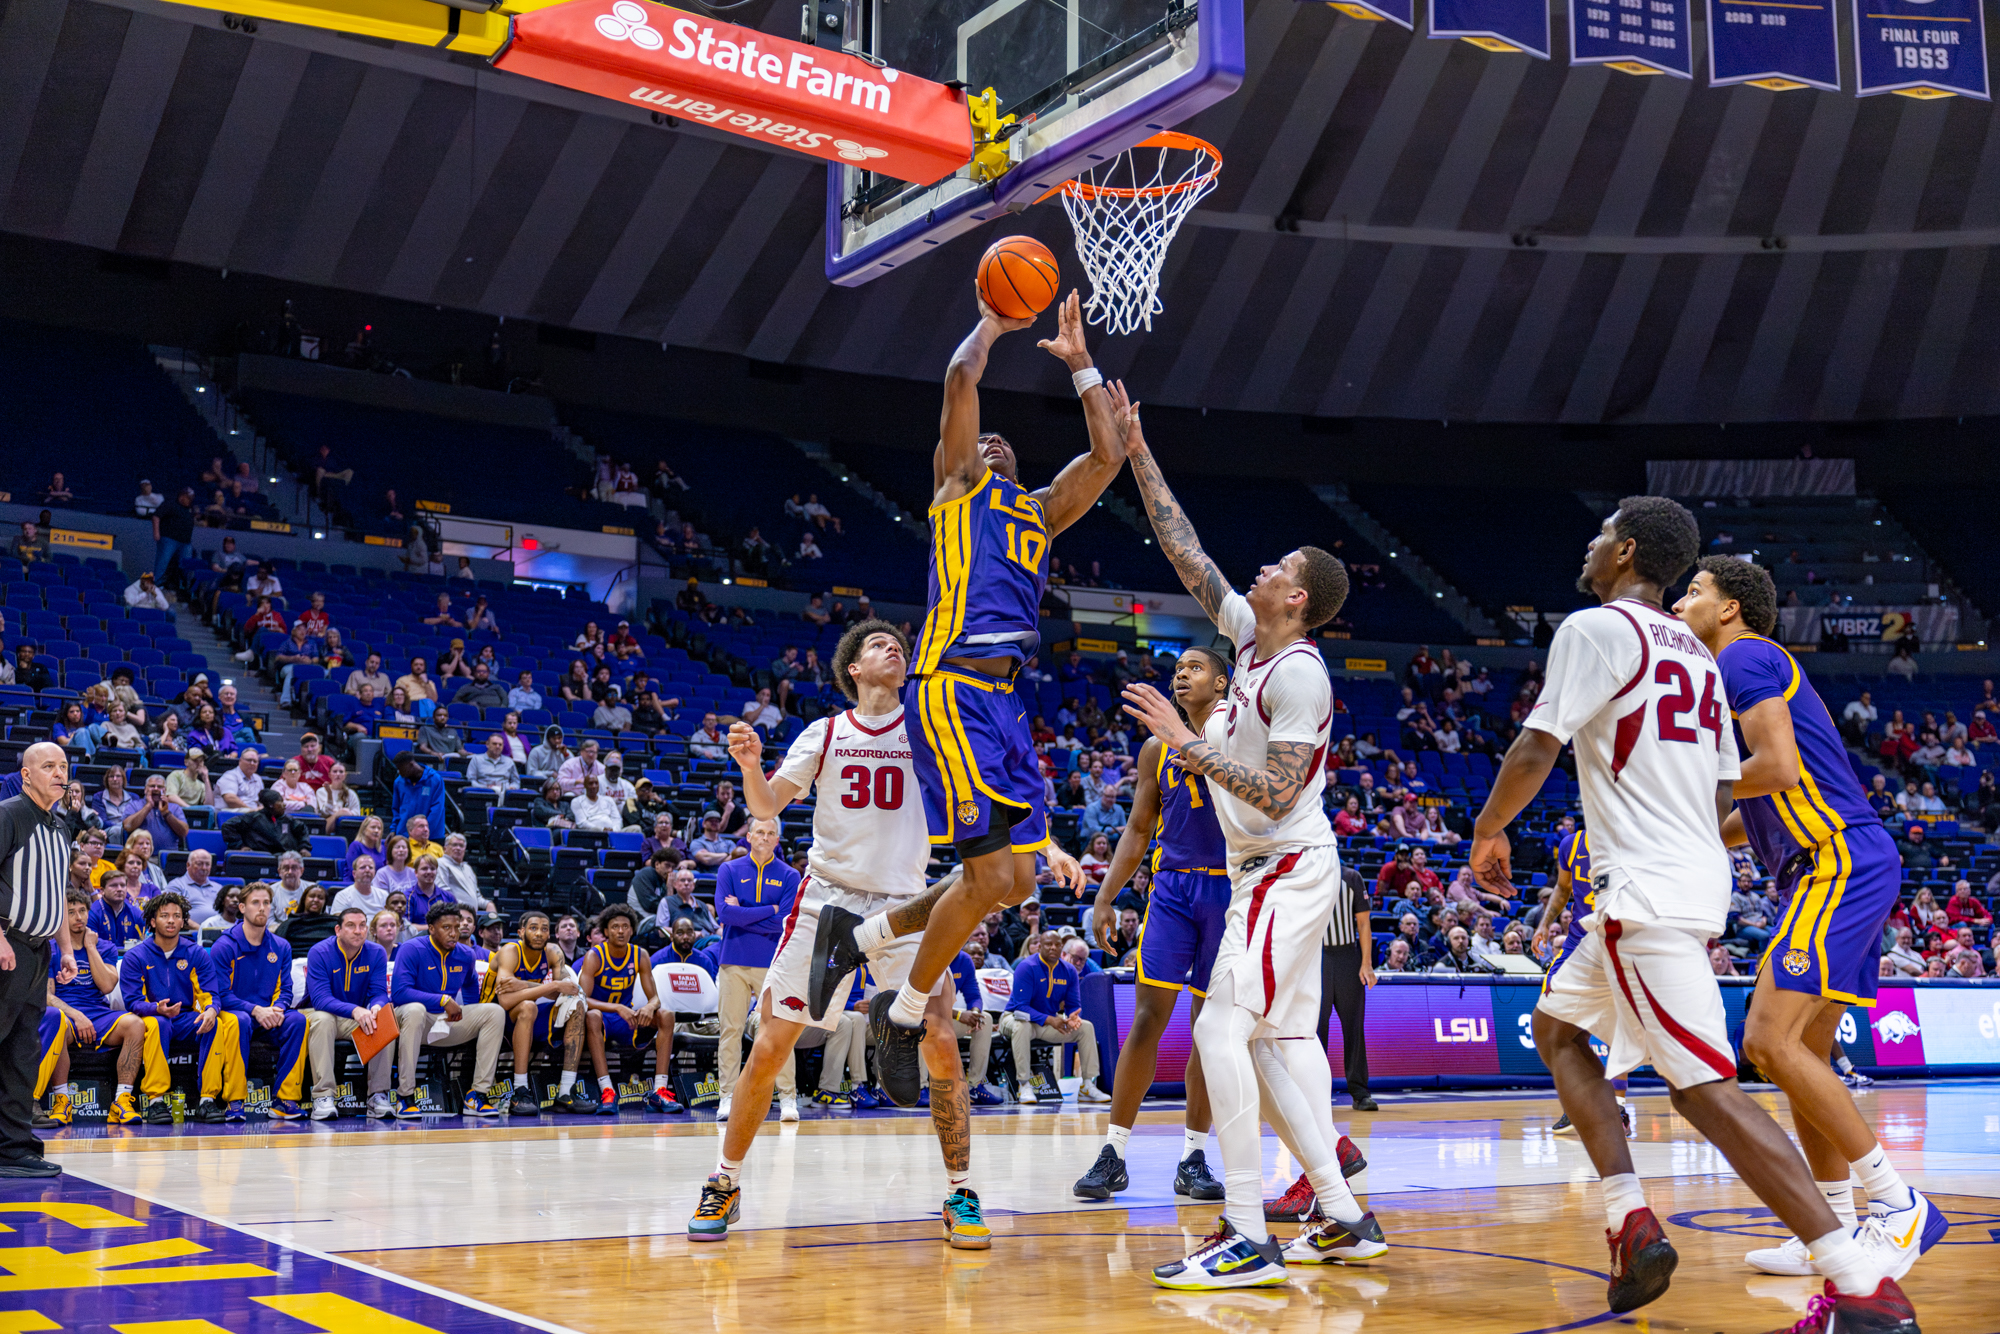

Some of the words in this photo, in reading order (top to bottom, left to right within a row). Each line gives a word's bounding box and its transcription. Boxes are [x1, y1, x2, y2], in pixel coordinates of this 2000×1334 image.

[1881, 27, 1920, 44] FINAL
[1923, 30, 1960, 45] FOUR
[1894, 46, 1949, 69] 1953
[1005, 522, 1047, 575] 10
[1822, 618, 1880, 636] WBRZ
[1655, 659, 1724, 754] 24
[834, 748, 913, 760] RAZORBACKS
[841, 765, 904, 810] 30
[1185, 773, 1204, 809] 1
[765, 878, 783, 887] LSU
[354, 965, 370, 974] LSU
[449, 965, 463, 973] LSU
[600, 976, 634, 990] LSU
[607, 991, 622, 1003] 0
[1434, 1018, 1489, 1043] LSU
[619, 1078, 654, 1097] Bengal
[696, 1079, 720, 1097] Beng
